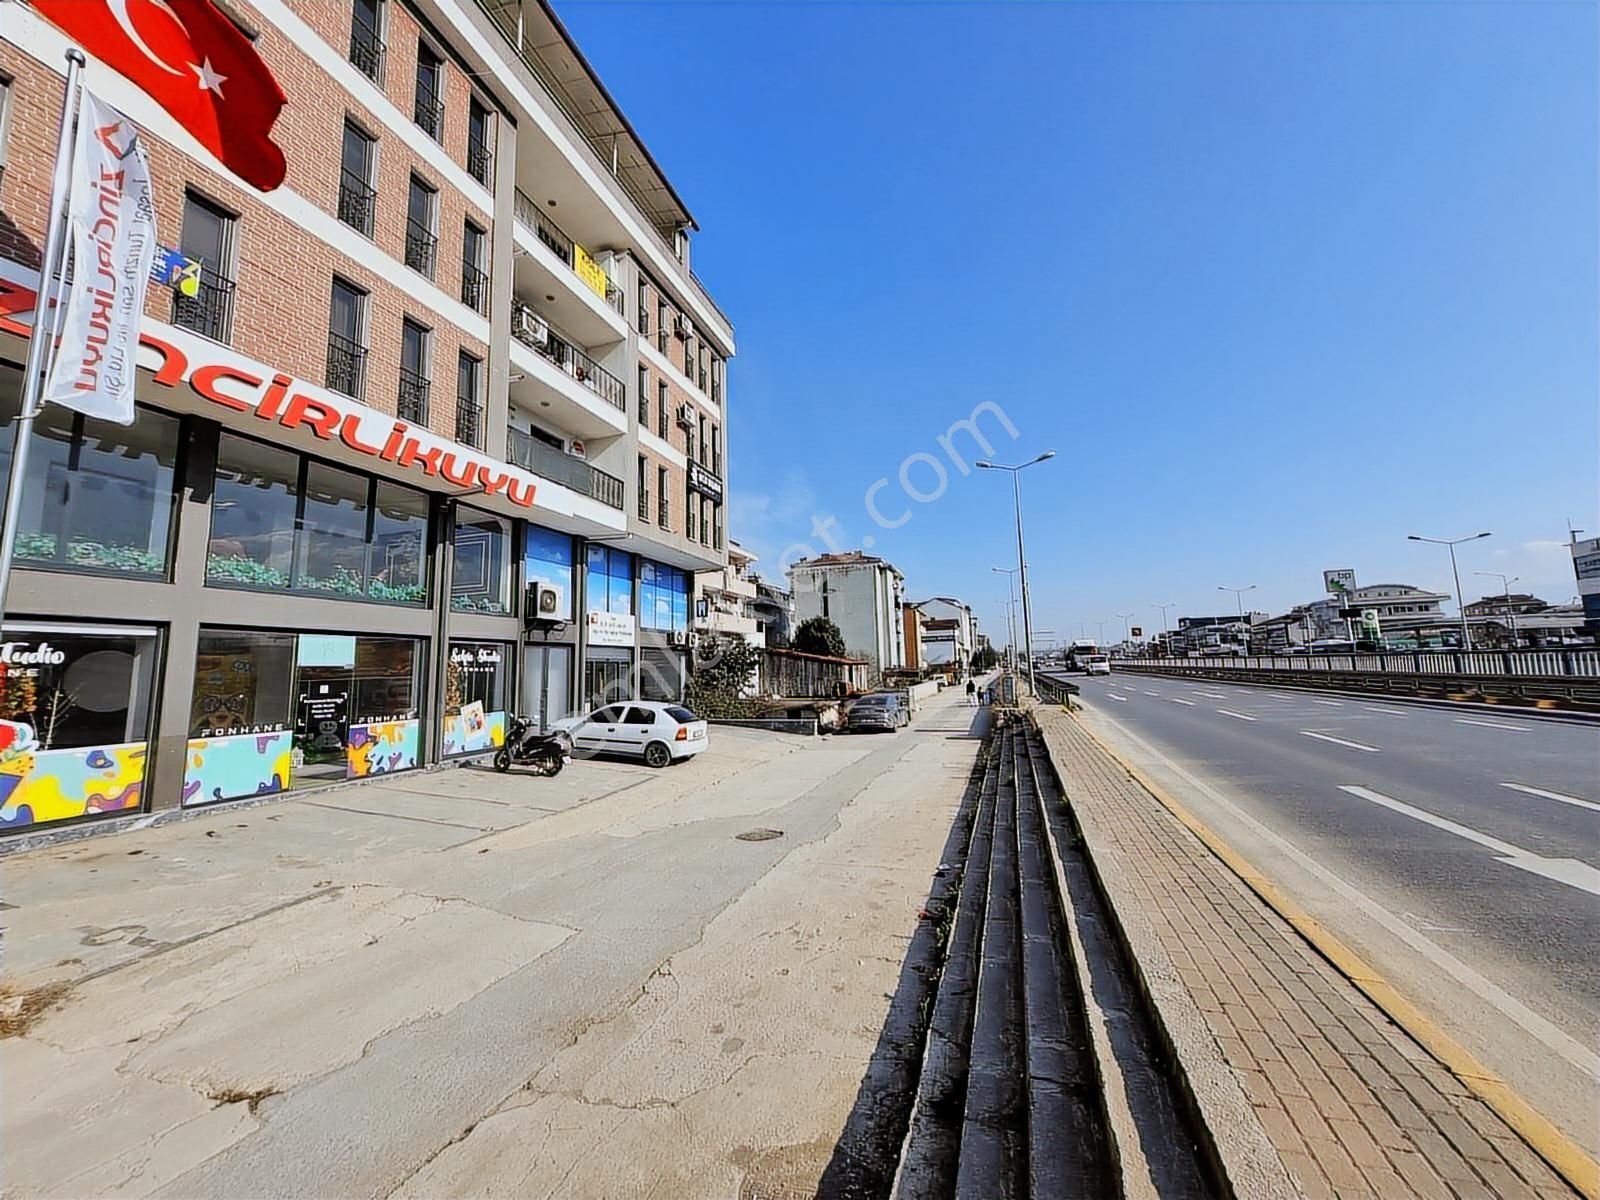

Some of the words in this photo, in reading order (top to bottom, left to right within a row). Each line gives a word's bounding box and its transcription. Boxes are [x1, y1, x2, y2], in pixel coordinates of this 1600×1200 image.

[1337, 572, 1352, 580] bp
[0, 641, 65, 665] tudio
[201, 723, 284, 738] FONHANE
